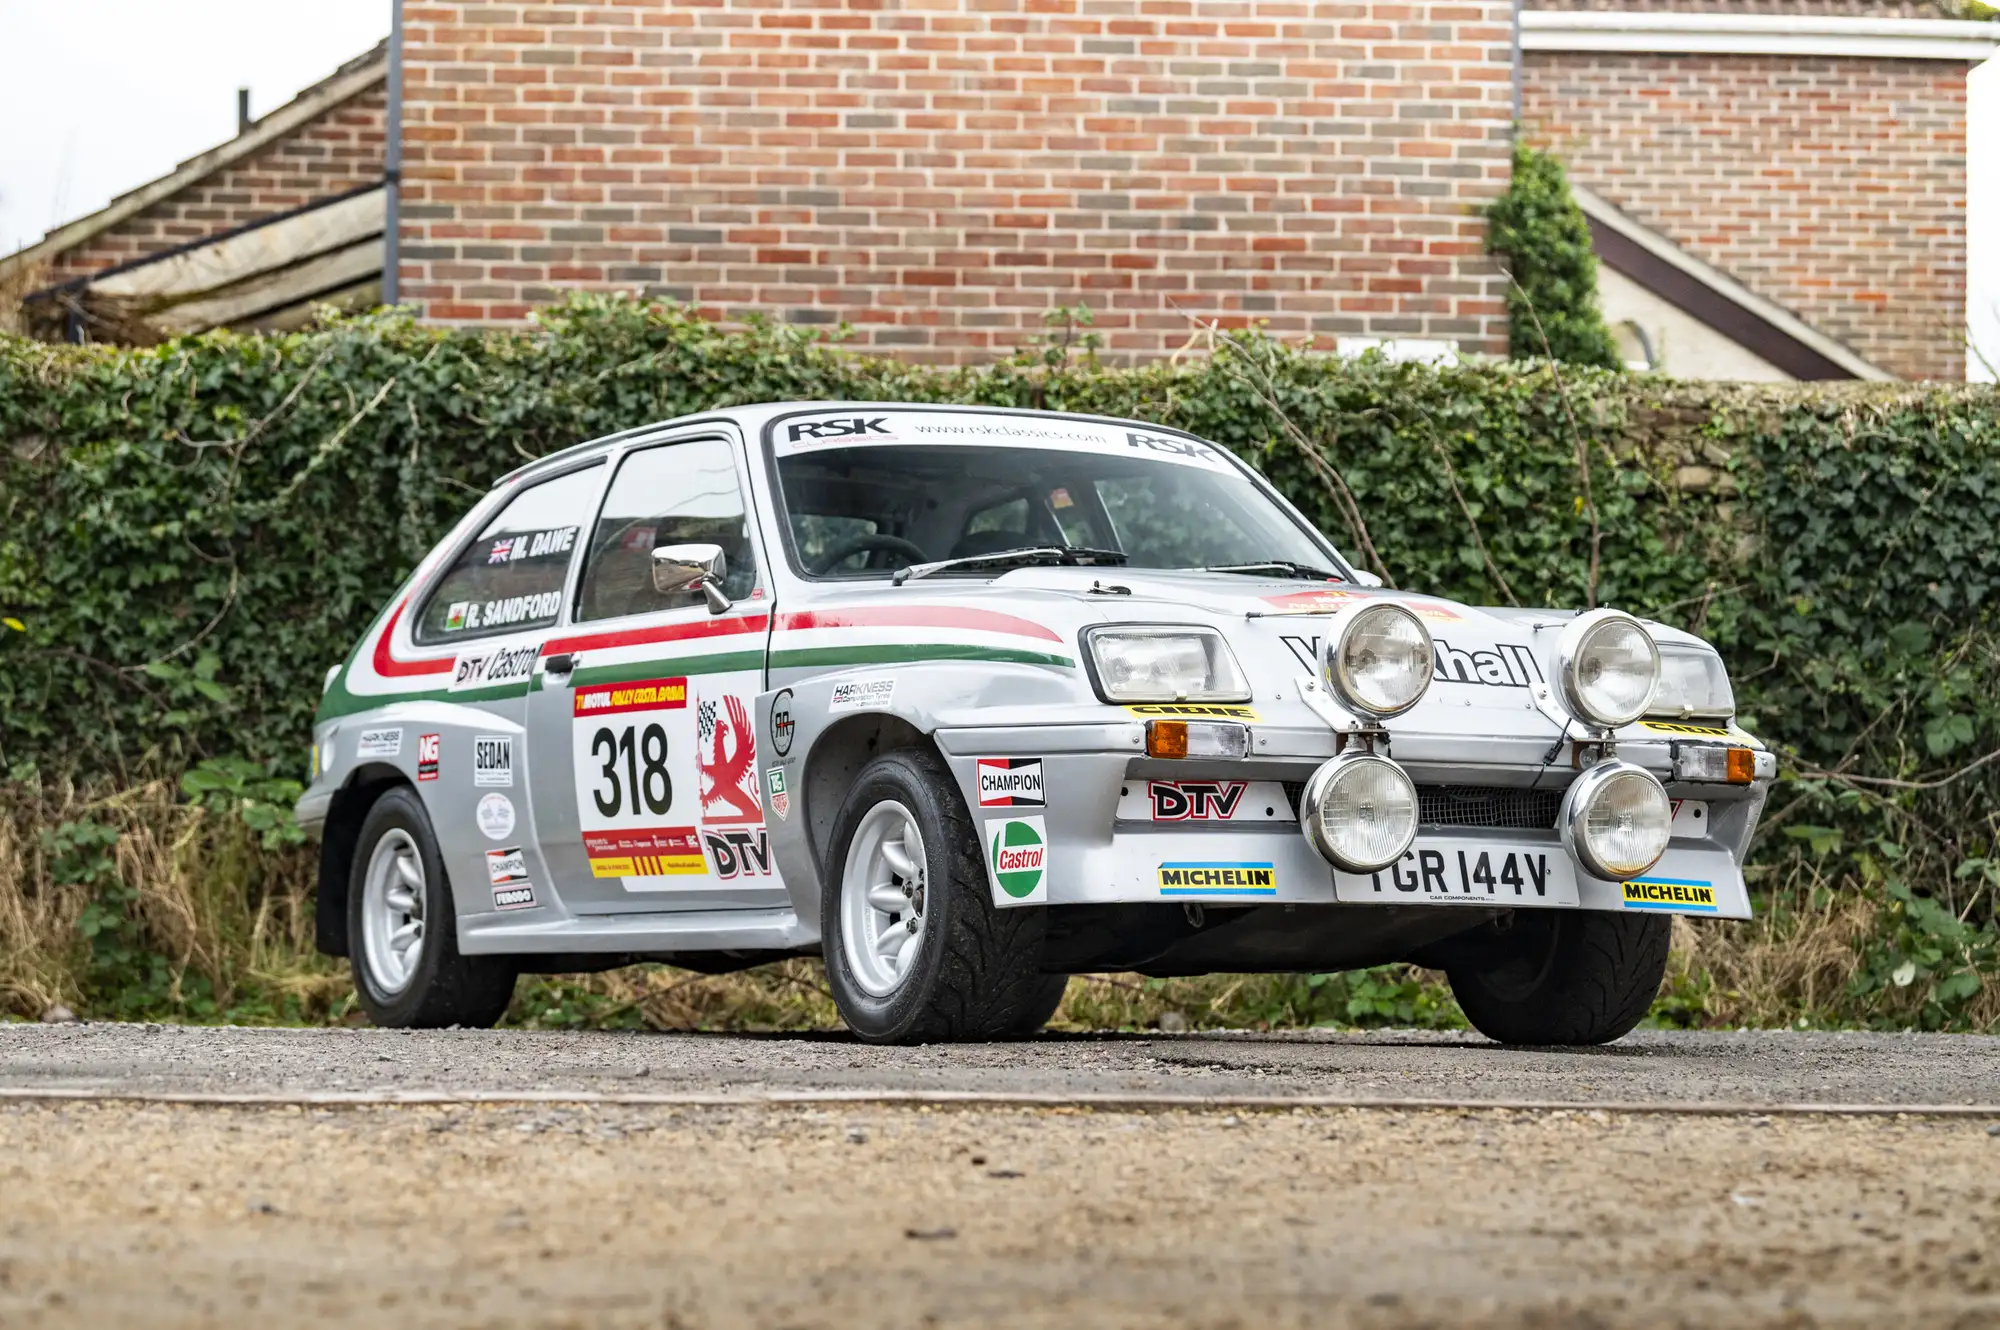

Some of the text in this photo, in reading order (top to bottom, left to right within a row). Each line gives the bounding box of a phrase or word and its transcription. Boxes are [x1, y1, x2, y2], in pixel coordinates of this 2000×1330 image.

[788, 418, 892, 441] RSK
[915, 424, 1107, 444] www.rskclassics.com
[1126, 433, 1215, 462] RSK
[509, 526, 577, 560] M. DAWE
[465, 591, 561, 628] R. SANDFORD
[456, 643, 544, 682] DTV Castrol
[1280, 636, 1545, 687] Vhall
[583, 692, 611, 709] MOTUL
[611, 689, 634, 706] RALLY
[634, 687, 657, 704] COSTA
[657, 685, 685, 702] BRAVA
[835, 680, 894, 697] HARKNESS
[419, 735, 440, 762] NG
[477, 742, 510, 769] SEDAN
[592, 722, 673, 817] 318
[981, 774, 1041, 791] CHAMPION
[1150, 783, 1245, 819] DTV
[703, 830, 770, 877] DTV
[1000, 847, 1043, 870] Castrol
[1161, 870, 1270, 886] MICHELIN
[1457, 850, 1546, 896] 144V
[496, 889, 532, 905] FERODO
[1624, 883, 1712, 902] MICHELIN
